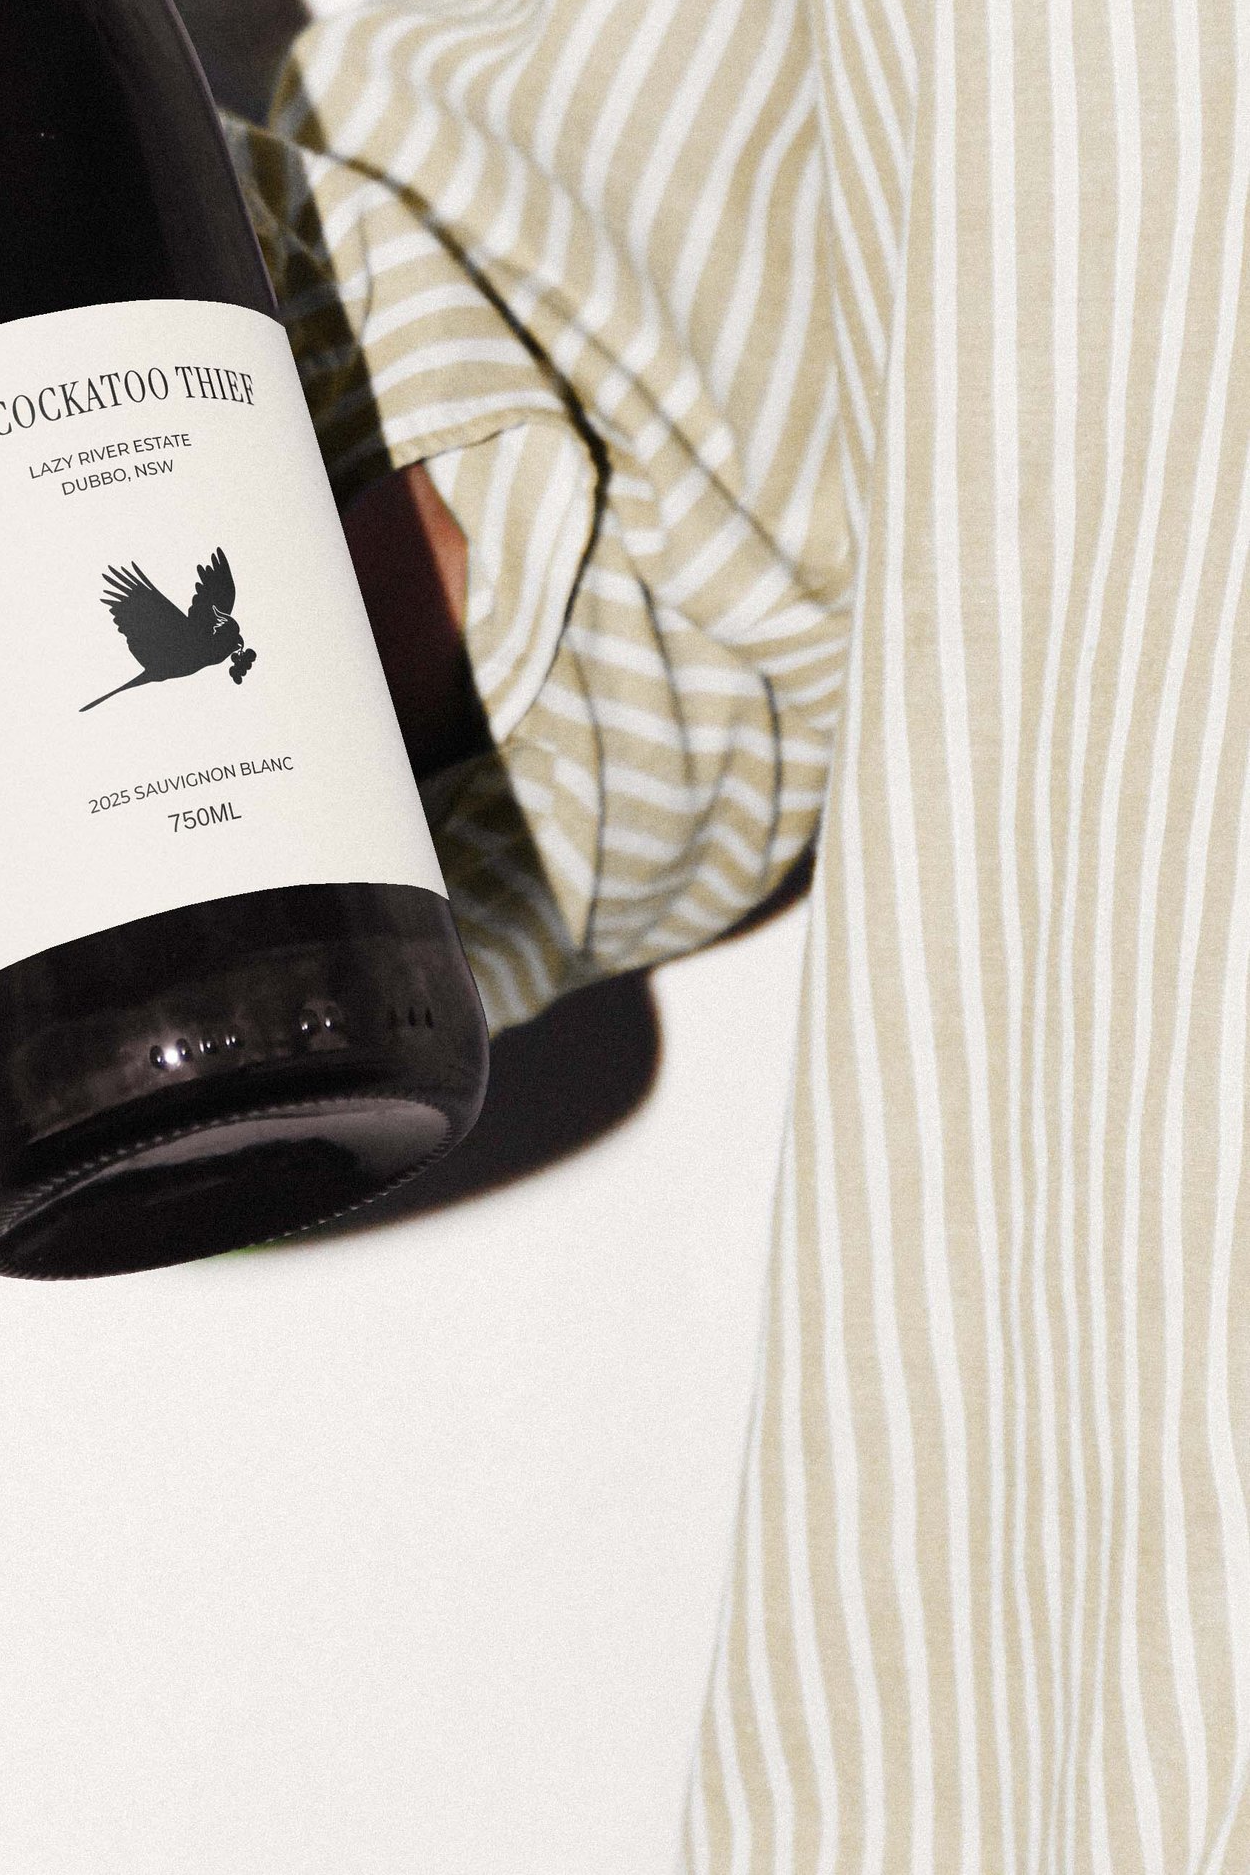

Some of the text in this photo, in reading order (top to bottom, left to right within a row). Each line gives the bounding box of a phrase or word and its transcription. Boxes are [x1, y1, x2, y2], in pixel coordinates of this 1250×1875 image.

[174, 365, 255, 406] THIEF
[28, 433, 192, 480] LAZY RIVER ESTATE
[61, 459, 174, 496] DUBBO, NSW
[88, 756, 294, 814] 2025 SAUVIGNON BLANC
[167, 801, 242, 833] 750ML
